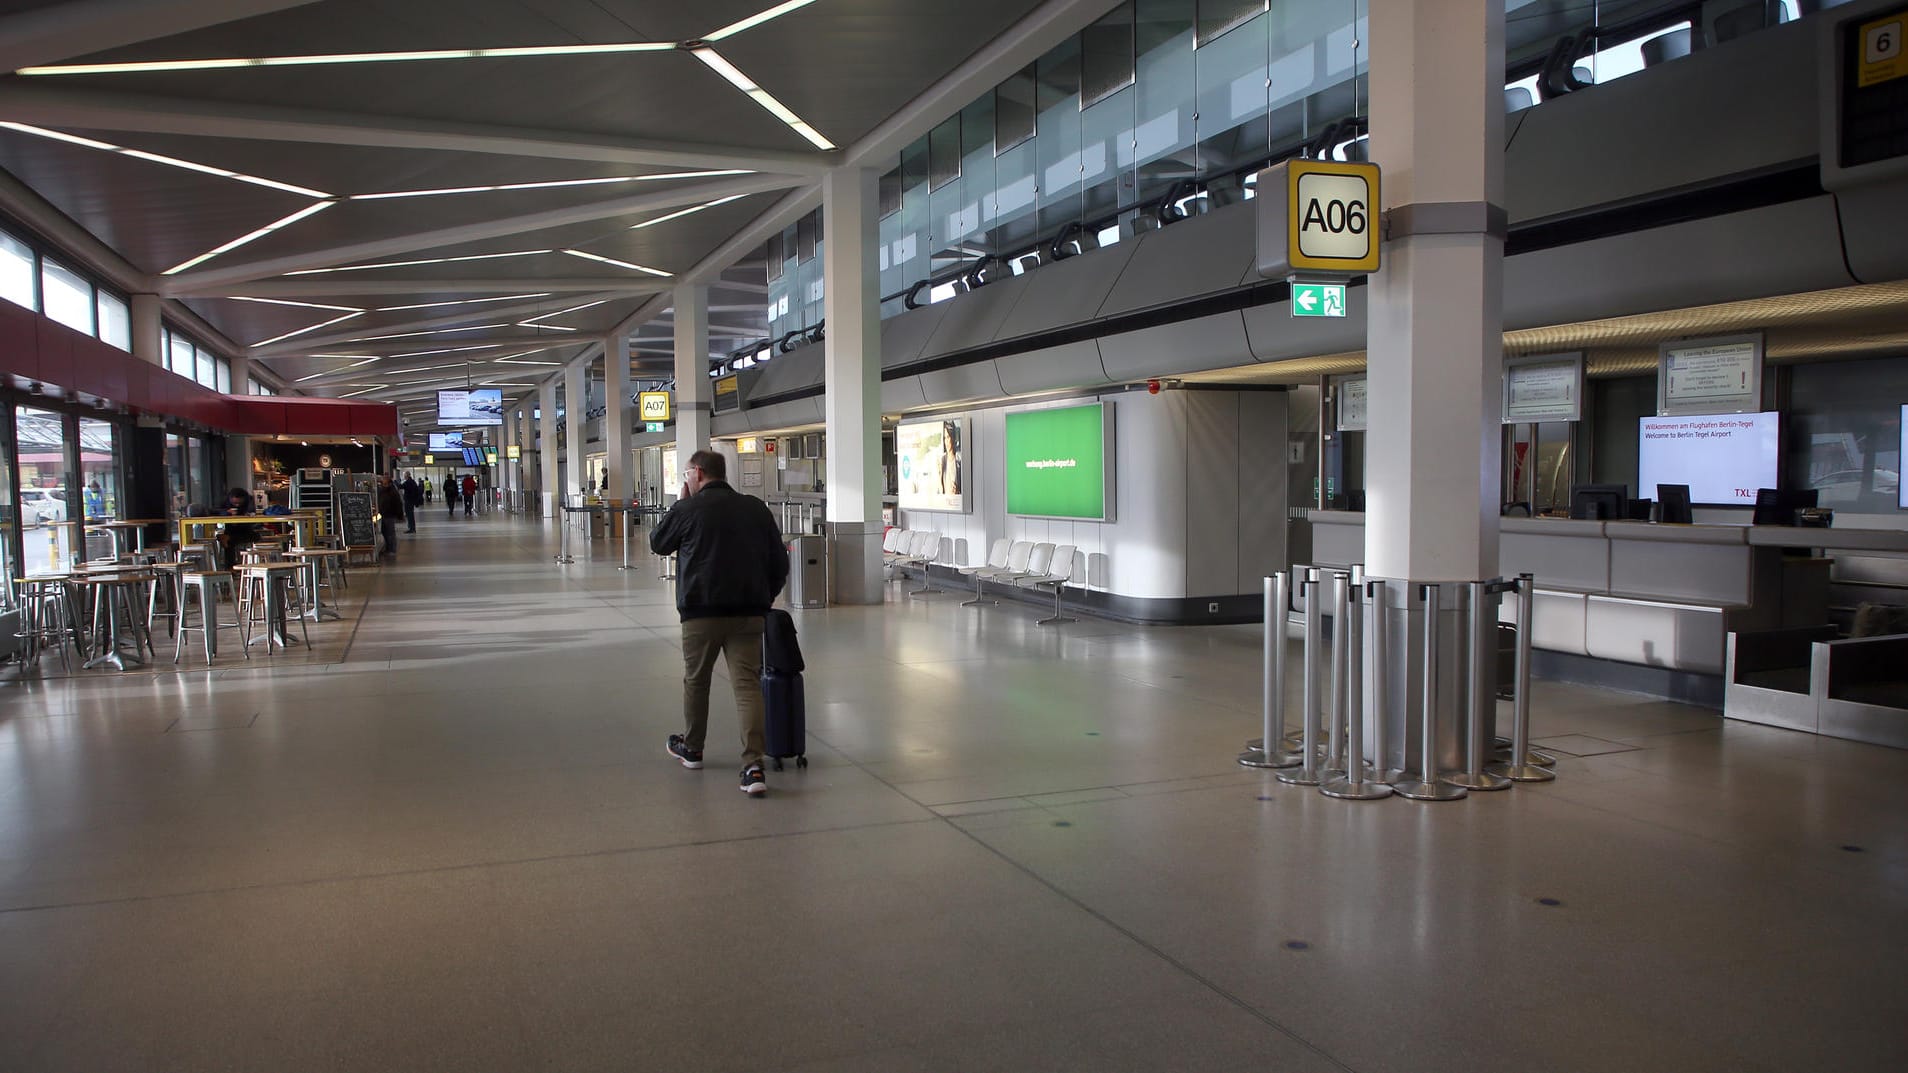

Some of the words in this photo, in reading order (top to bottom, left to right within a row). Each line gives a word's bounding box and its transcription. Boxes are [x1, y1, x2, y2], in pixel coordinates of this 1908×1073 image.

[1876, 32, 1890, 53] 6
[1302, 198, 1366, 235] A06
[645, 401, 665, 411] A07
[1690, 421, 1718, 430] Flughafen
[1695, 431, 1710, 439] Tegel
[1711, 430, 1732, 438] Airport
[1735, 488, 1751, 498] TXL
